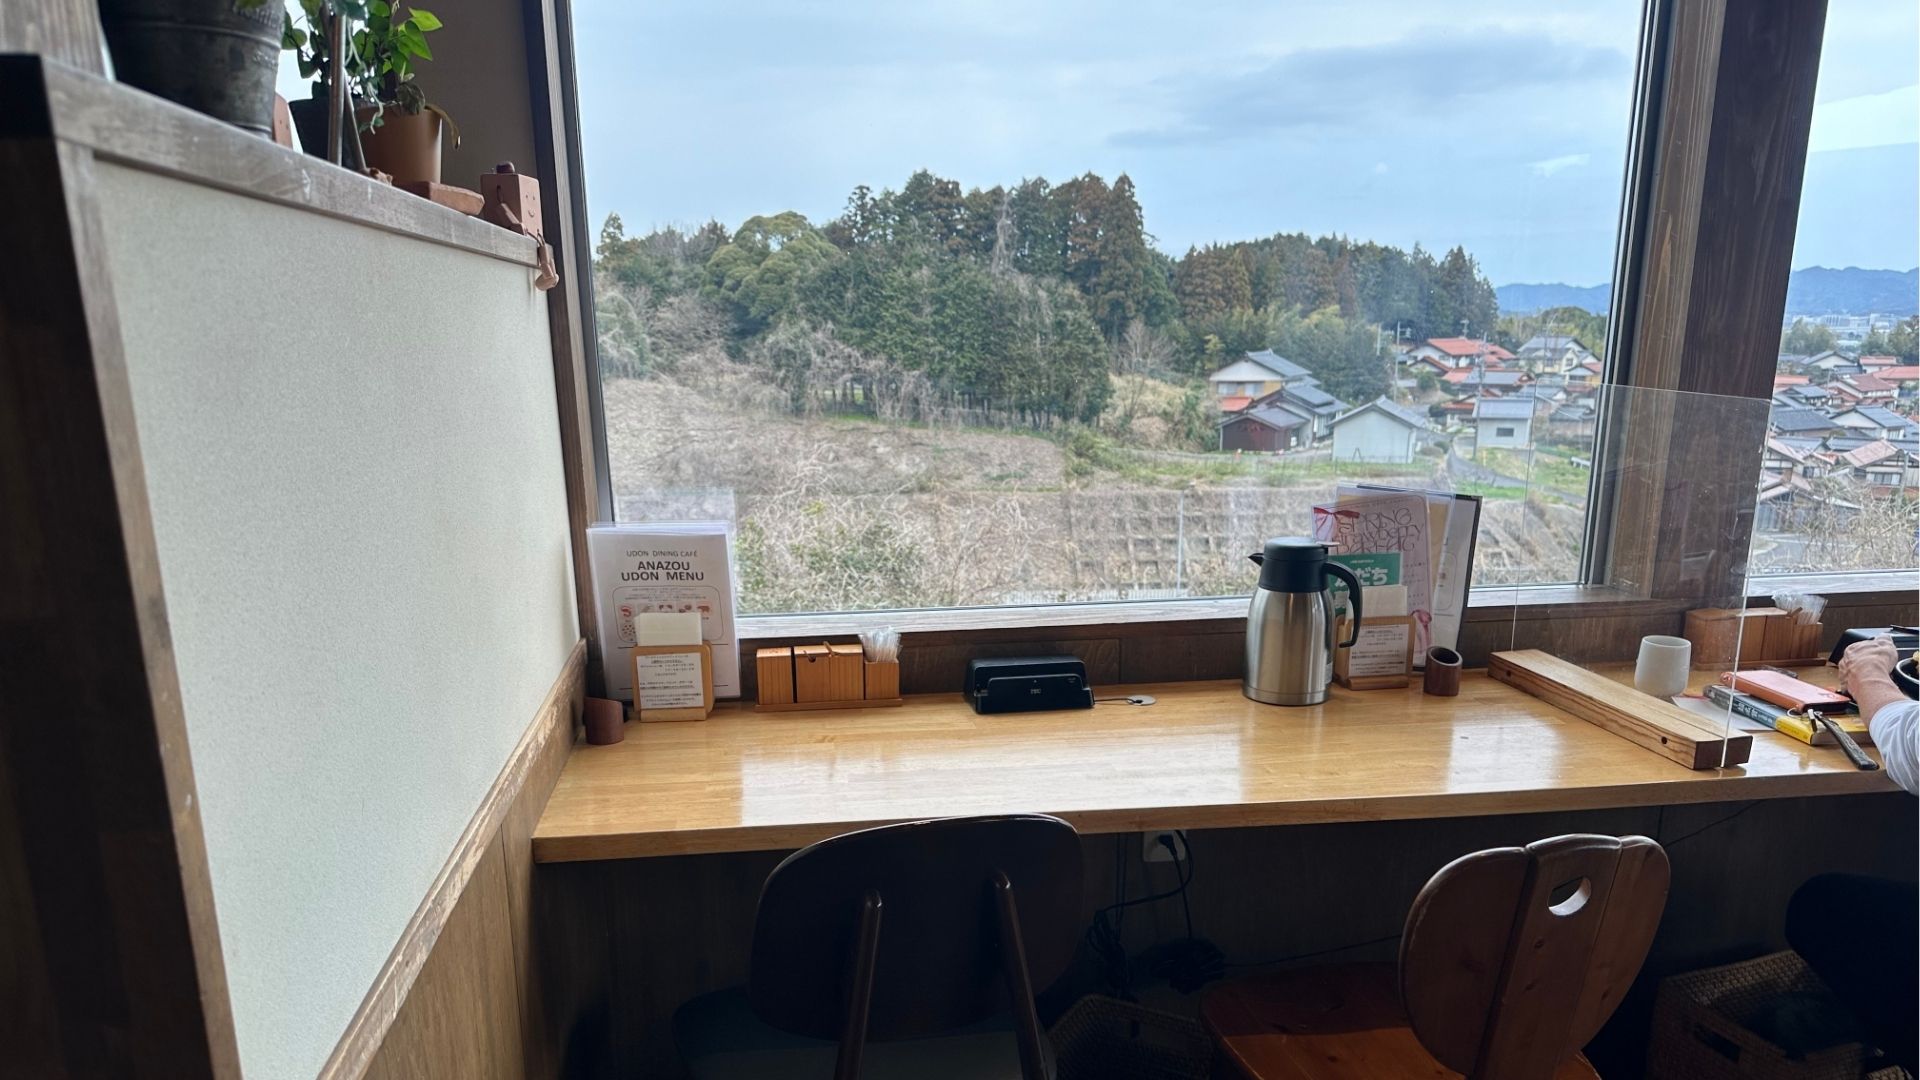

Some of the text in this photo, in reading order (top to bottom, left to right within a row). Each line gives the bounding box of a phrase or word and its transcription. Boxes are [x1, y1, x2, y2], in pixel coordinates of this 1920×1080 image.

[638, 561, 690, 570] ANAZOU
[621, 571, 704, 581] UDON MENU
